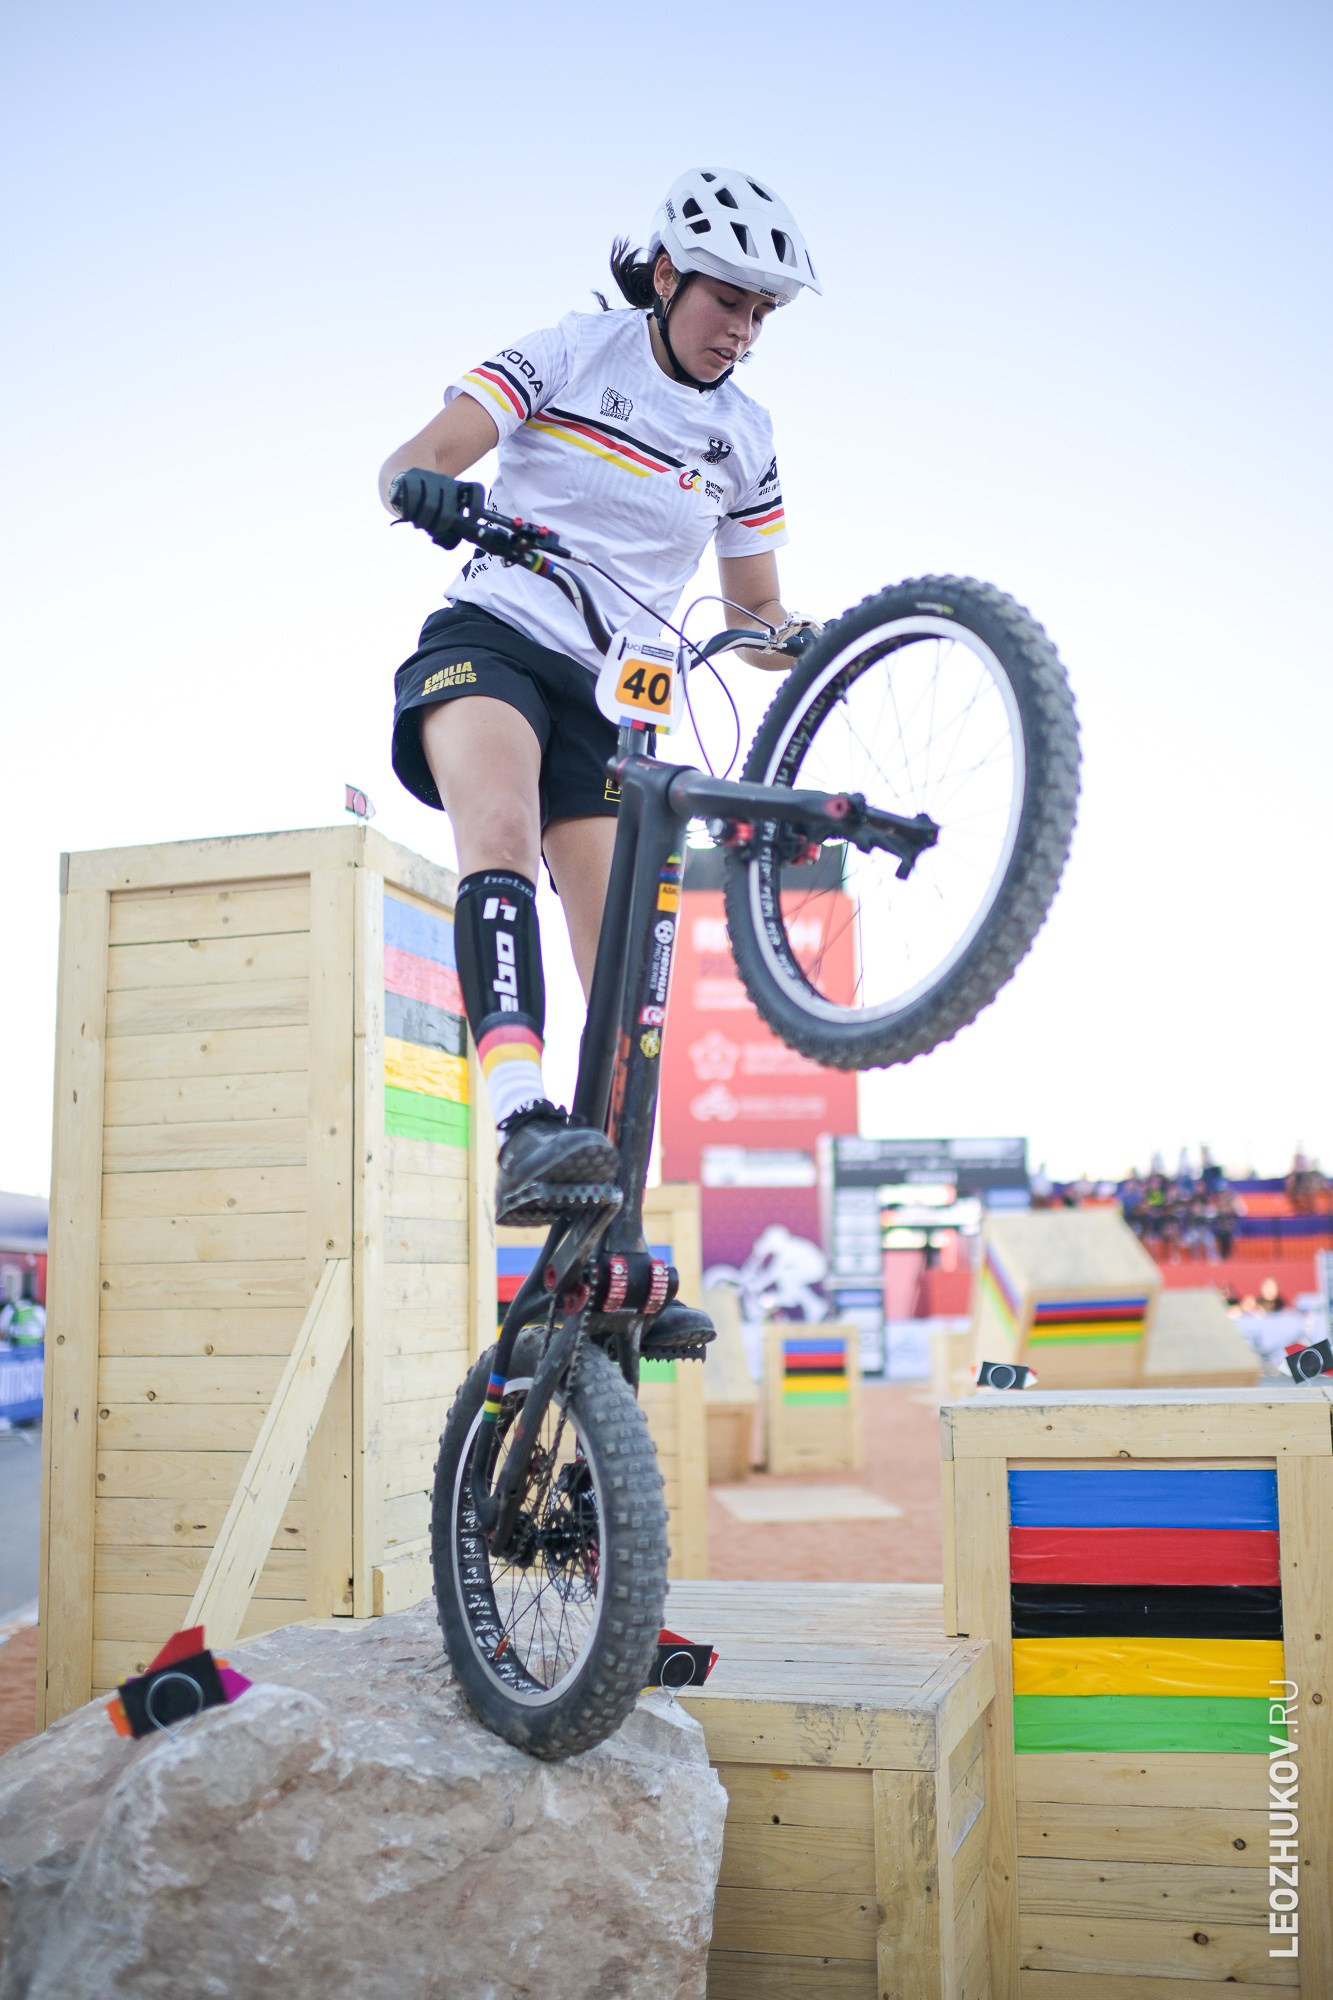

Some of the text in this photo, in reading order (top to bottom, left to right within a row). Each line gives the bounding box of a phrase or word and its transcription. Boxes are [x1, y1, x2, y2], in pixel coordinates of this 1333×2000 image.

[665, 199, 676, 223] uvex
[760, 288, 777, 298] uvex
[496, 348, 544, 398] KODA
[600, 410, 629, 422] BIORACER
[627, 643, 640, 651] UCI
[424, 661, 473, 690] EMILIA
[623, 667, 671, 706] 40
[483, 875, 534, 898] hebo
